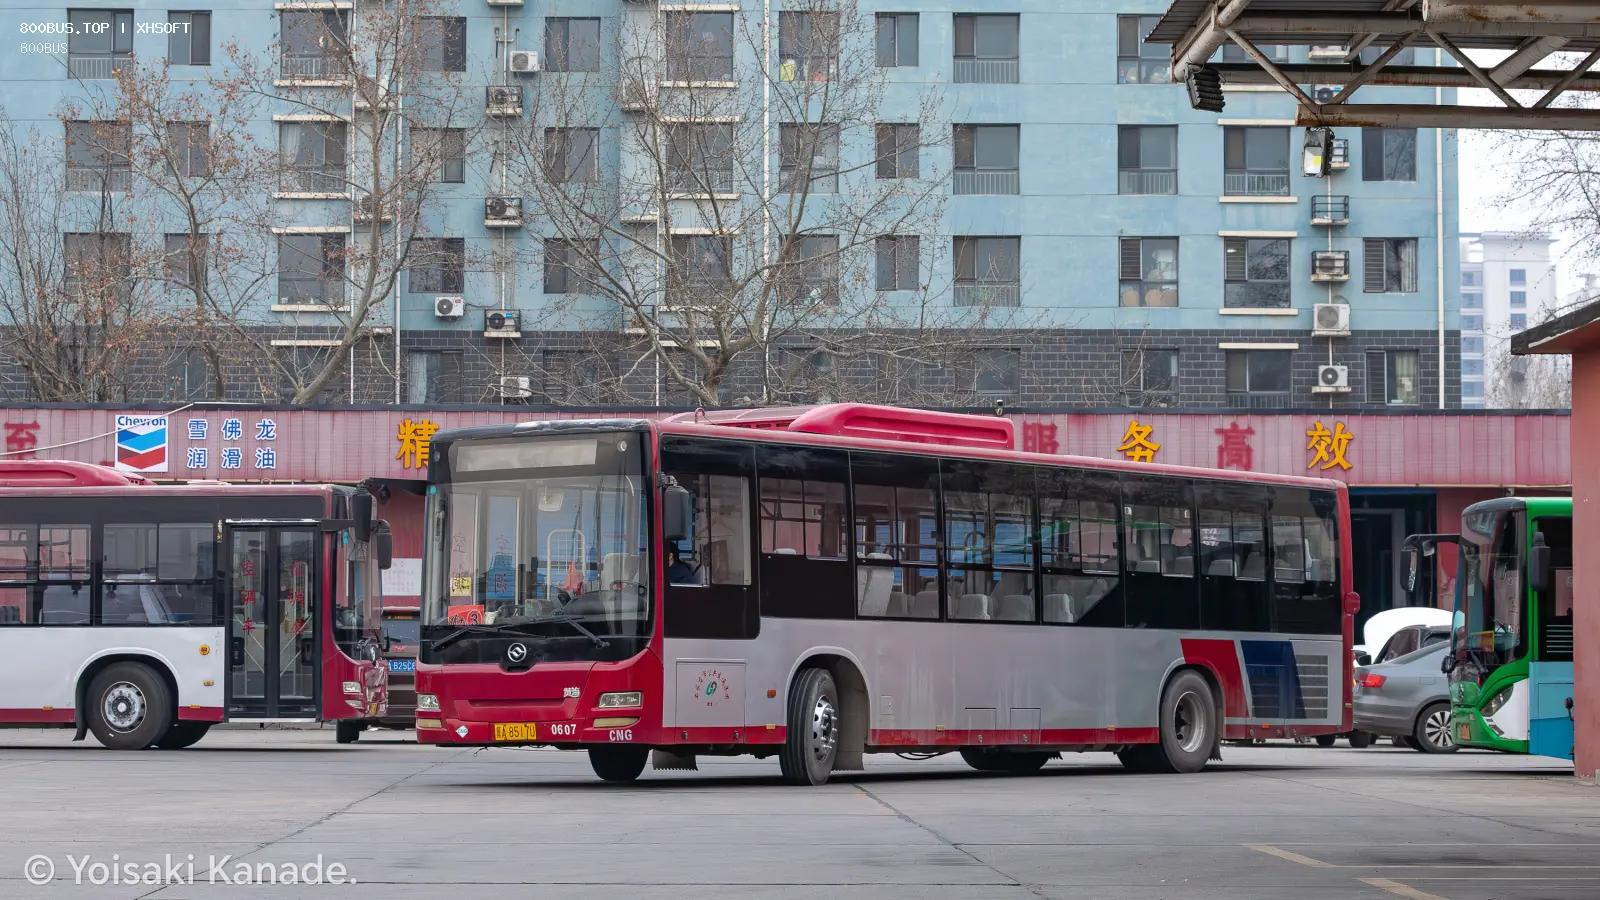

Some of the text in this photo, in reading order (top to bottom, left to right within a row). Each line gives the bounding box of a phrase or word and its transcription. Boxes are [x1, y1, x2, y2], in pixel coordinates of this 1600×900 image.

[117, 415, 167, 427] Chevron
[187, 418, 277, 441] 雪佛龙
[187, 448, 276, 469] 润滑油
[551, 724, 577, 736] 0607
[609, 730, 632, 743] CNG
